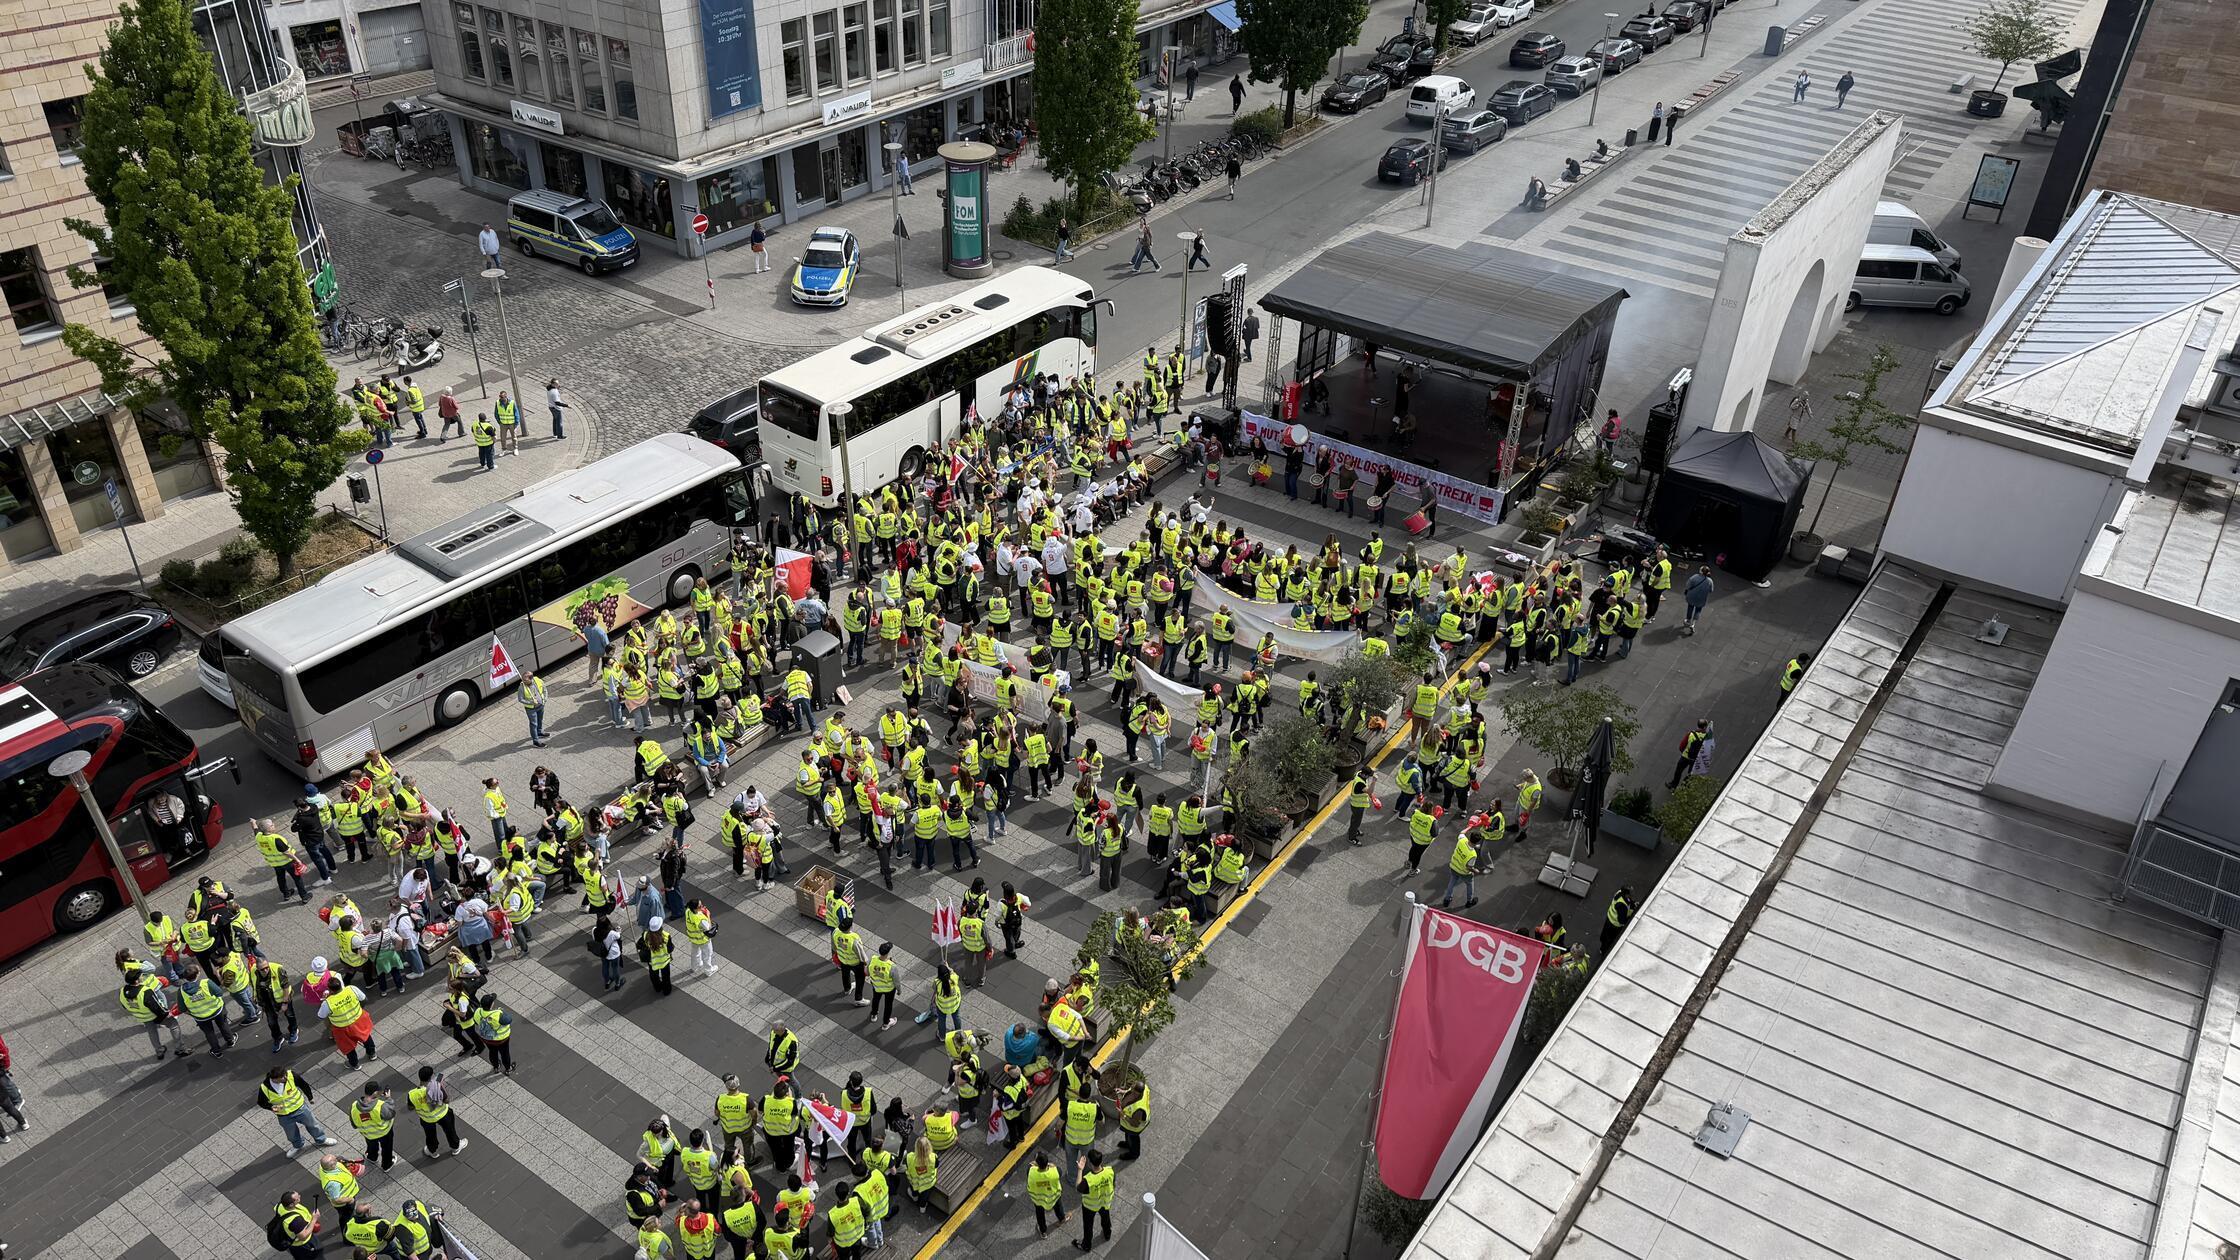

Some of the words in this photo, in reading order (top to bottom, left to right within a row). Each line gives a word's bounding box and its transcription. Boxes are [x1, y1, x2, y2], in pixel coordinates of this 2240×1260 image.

[841, 99, 870, 113] VAUDE
[526, 112, 558, 128] VAUDE
[955, 205, 975, 219] FOM
[603, 232, 627, 245] POLIZEI
[1721, 298, 1737, 308] DES
[662, 548, 685, 568] 50
[1022, 564, 1028, 572] 9
[1427, 912, 1527, 984] DGB
